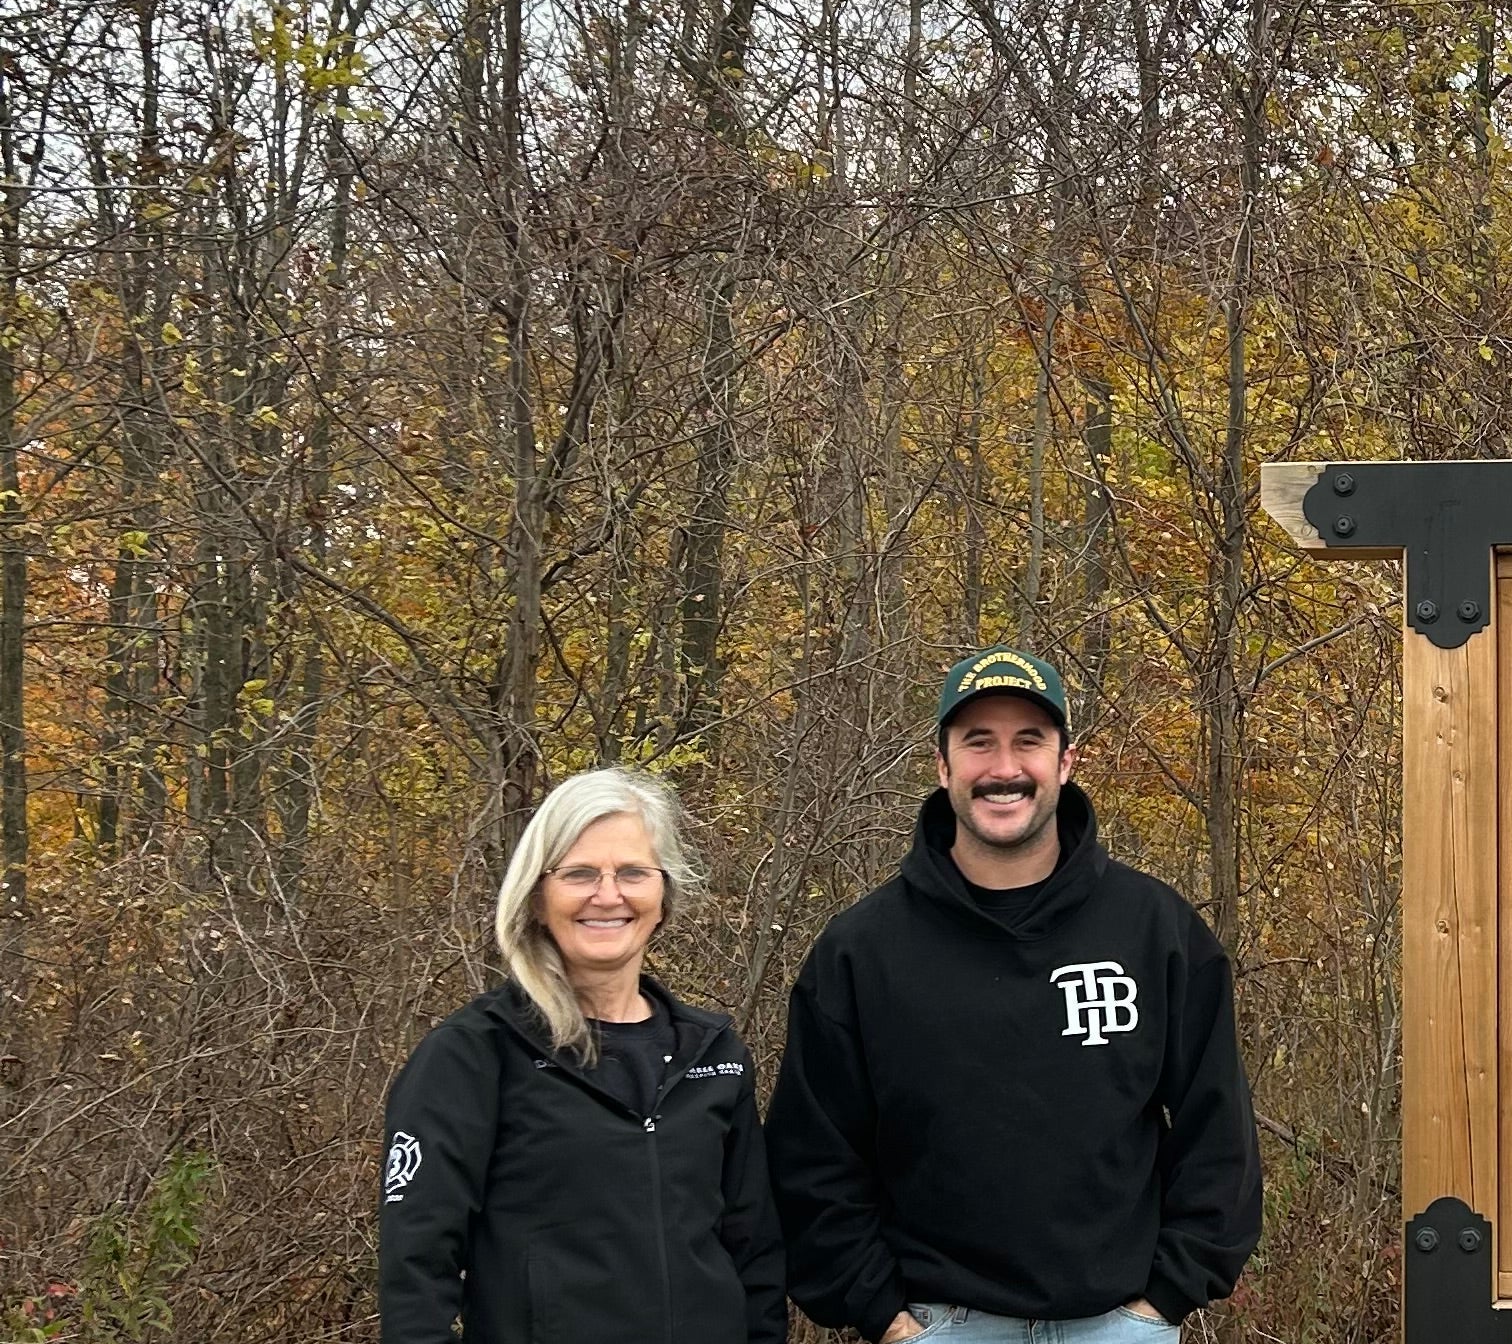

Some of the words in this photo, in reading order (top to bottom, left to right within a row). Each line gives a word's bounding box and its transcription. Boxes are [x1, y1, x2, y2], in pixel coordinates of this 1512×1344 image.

[957, 671, 977, 693] THE
[973, 652, 1048, 691] BROTHERHOOD
[975, 675, 1033, 691] PROJECT
